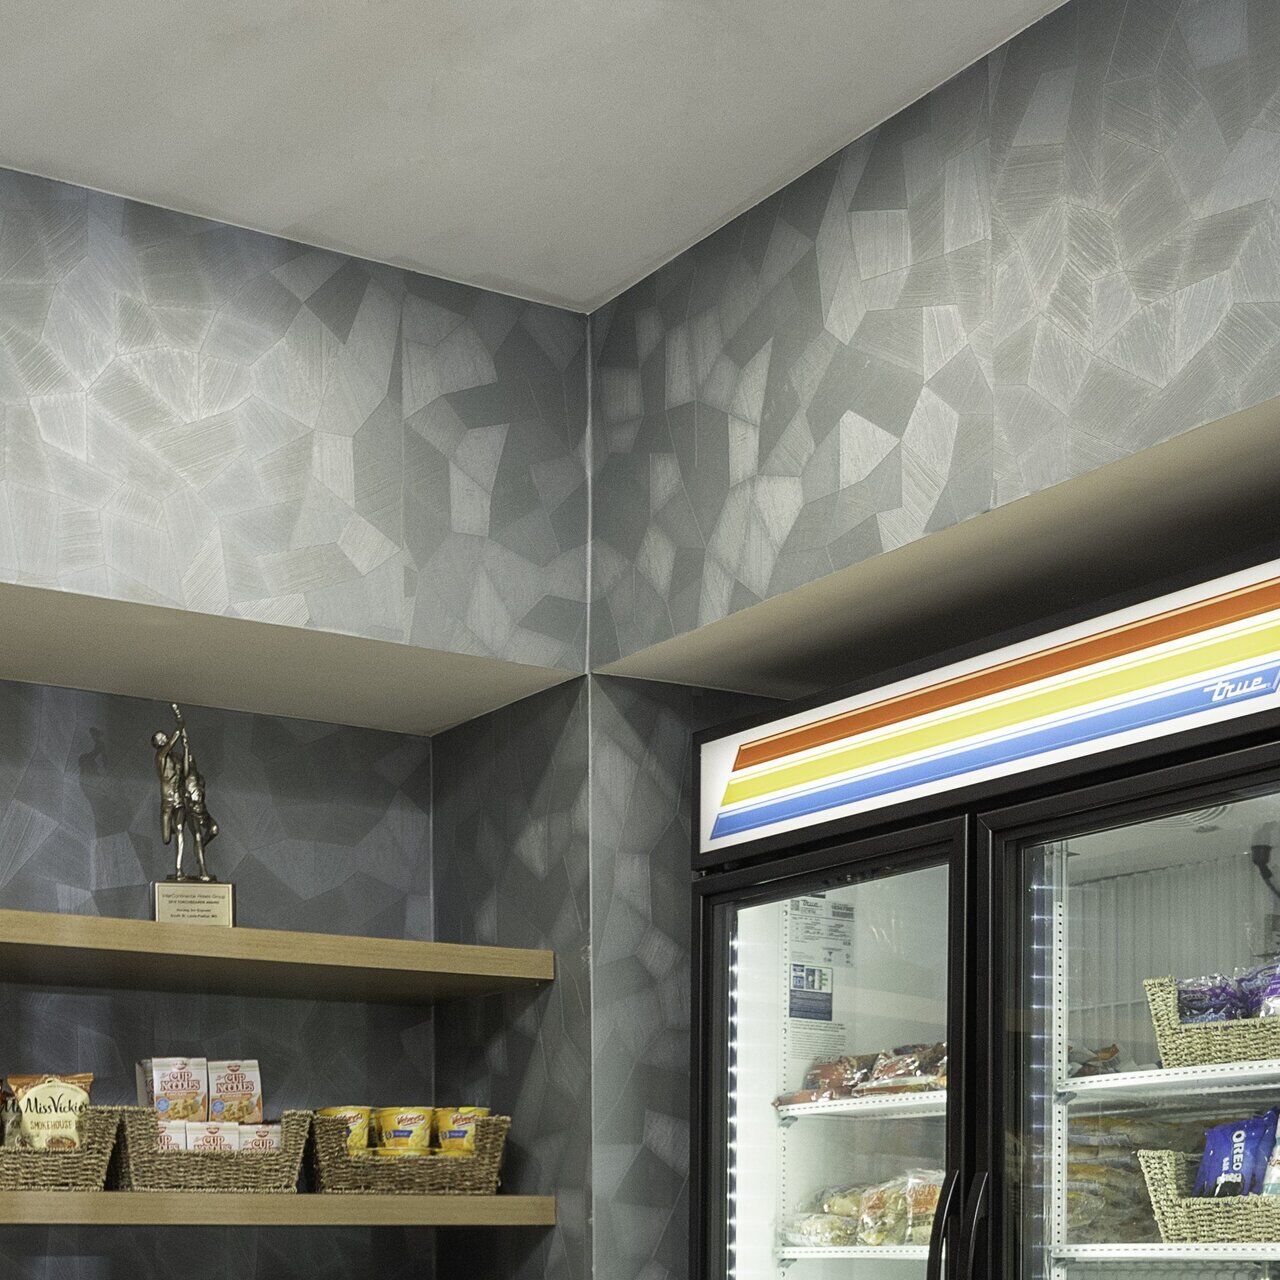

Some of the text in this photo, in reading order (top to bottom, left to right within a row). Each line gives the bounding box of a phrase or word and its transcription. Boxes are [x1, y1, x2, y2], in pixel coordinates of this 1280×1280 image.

[169, 1071, 192, 1081] CUP
[224, 1073, 246, 1083] CUP
[160, 1080, 200, 1092] NOODLES
[216, 1082, 254, 1093] NOODLES
[25, 1097, 52, 1114] Miss
[202, 1136, 225, 1146] CUP
[1232, 1130, 1246, 1171] OREO
